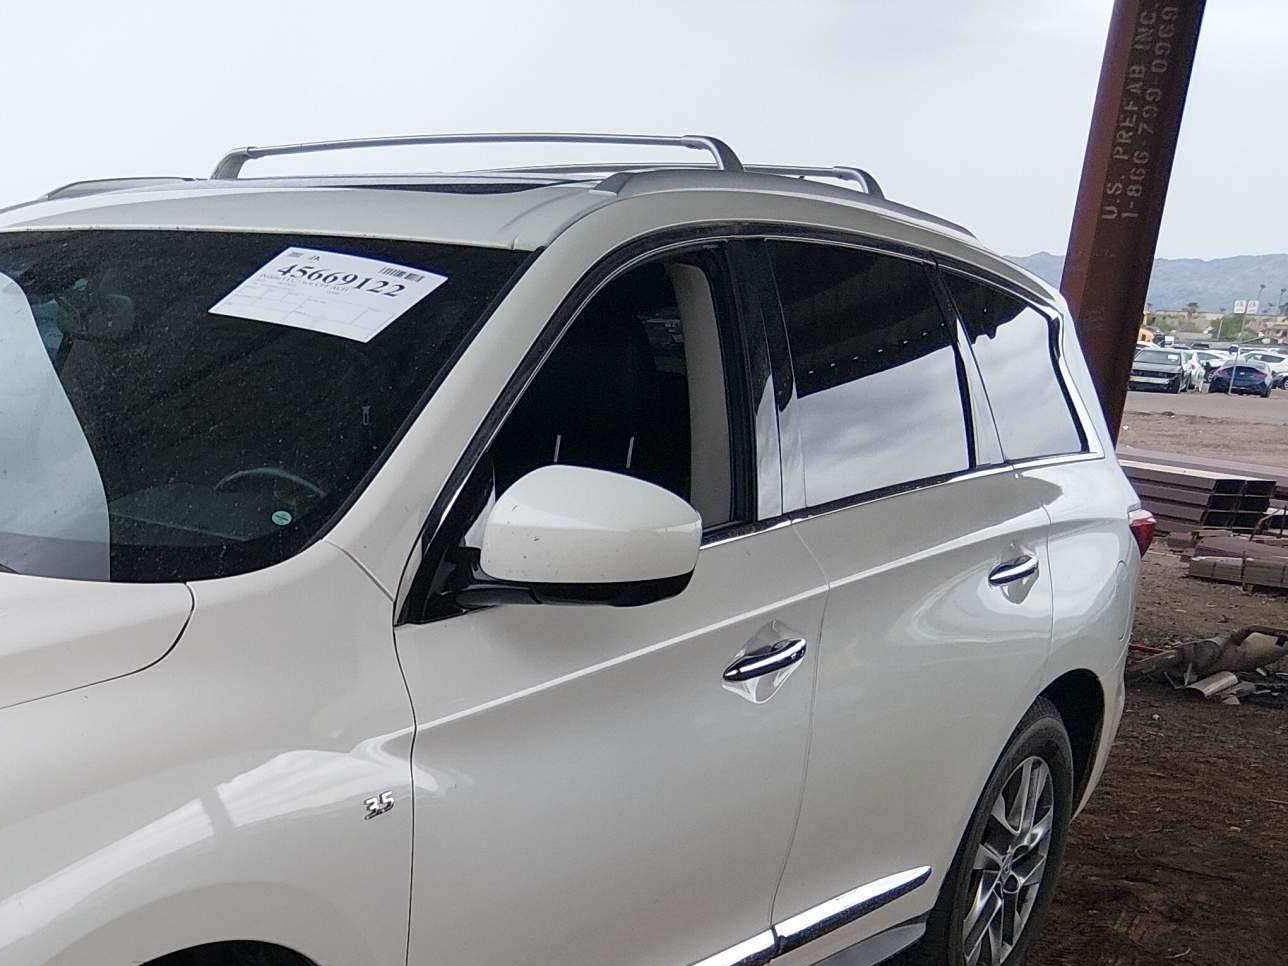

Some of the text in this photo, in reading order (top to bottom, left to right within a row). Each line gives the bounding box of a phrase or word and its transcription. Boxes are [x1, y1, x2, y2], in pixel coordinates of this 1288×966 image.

[1102, 2, 1160, 219] U.S. PREFAB INC.
[277, 263, 406, 298] 45669122
